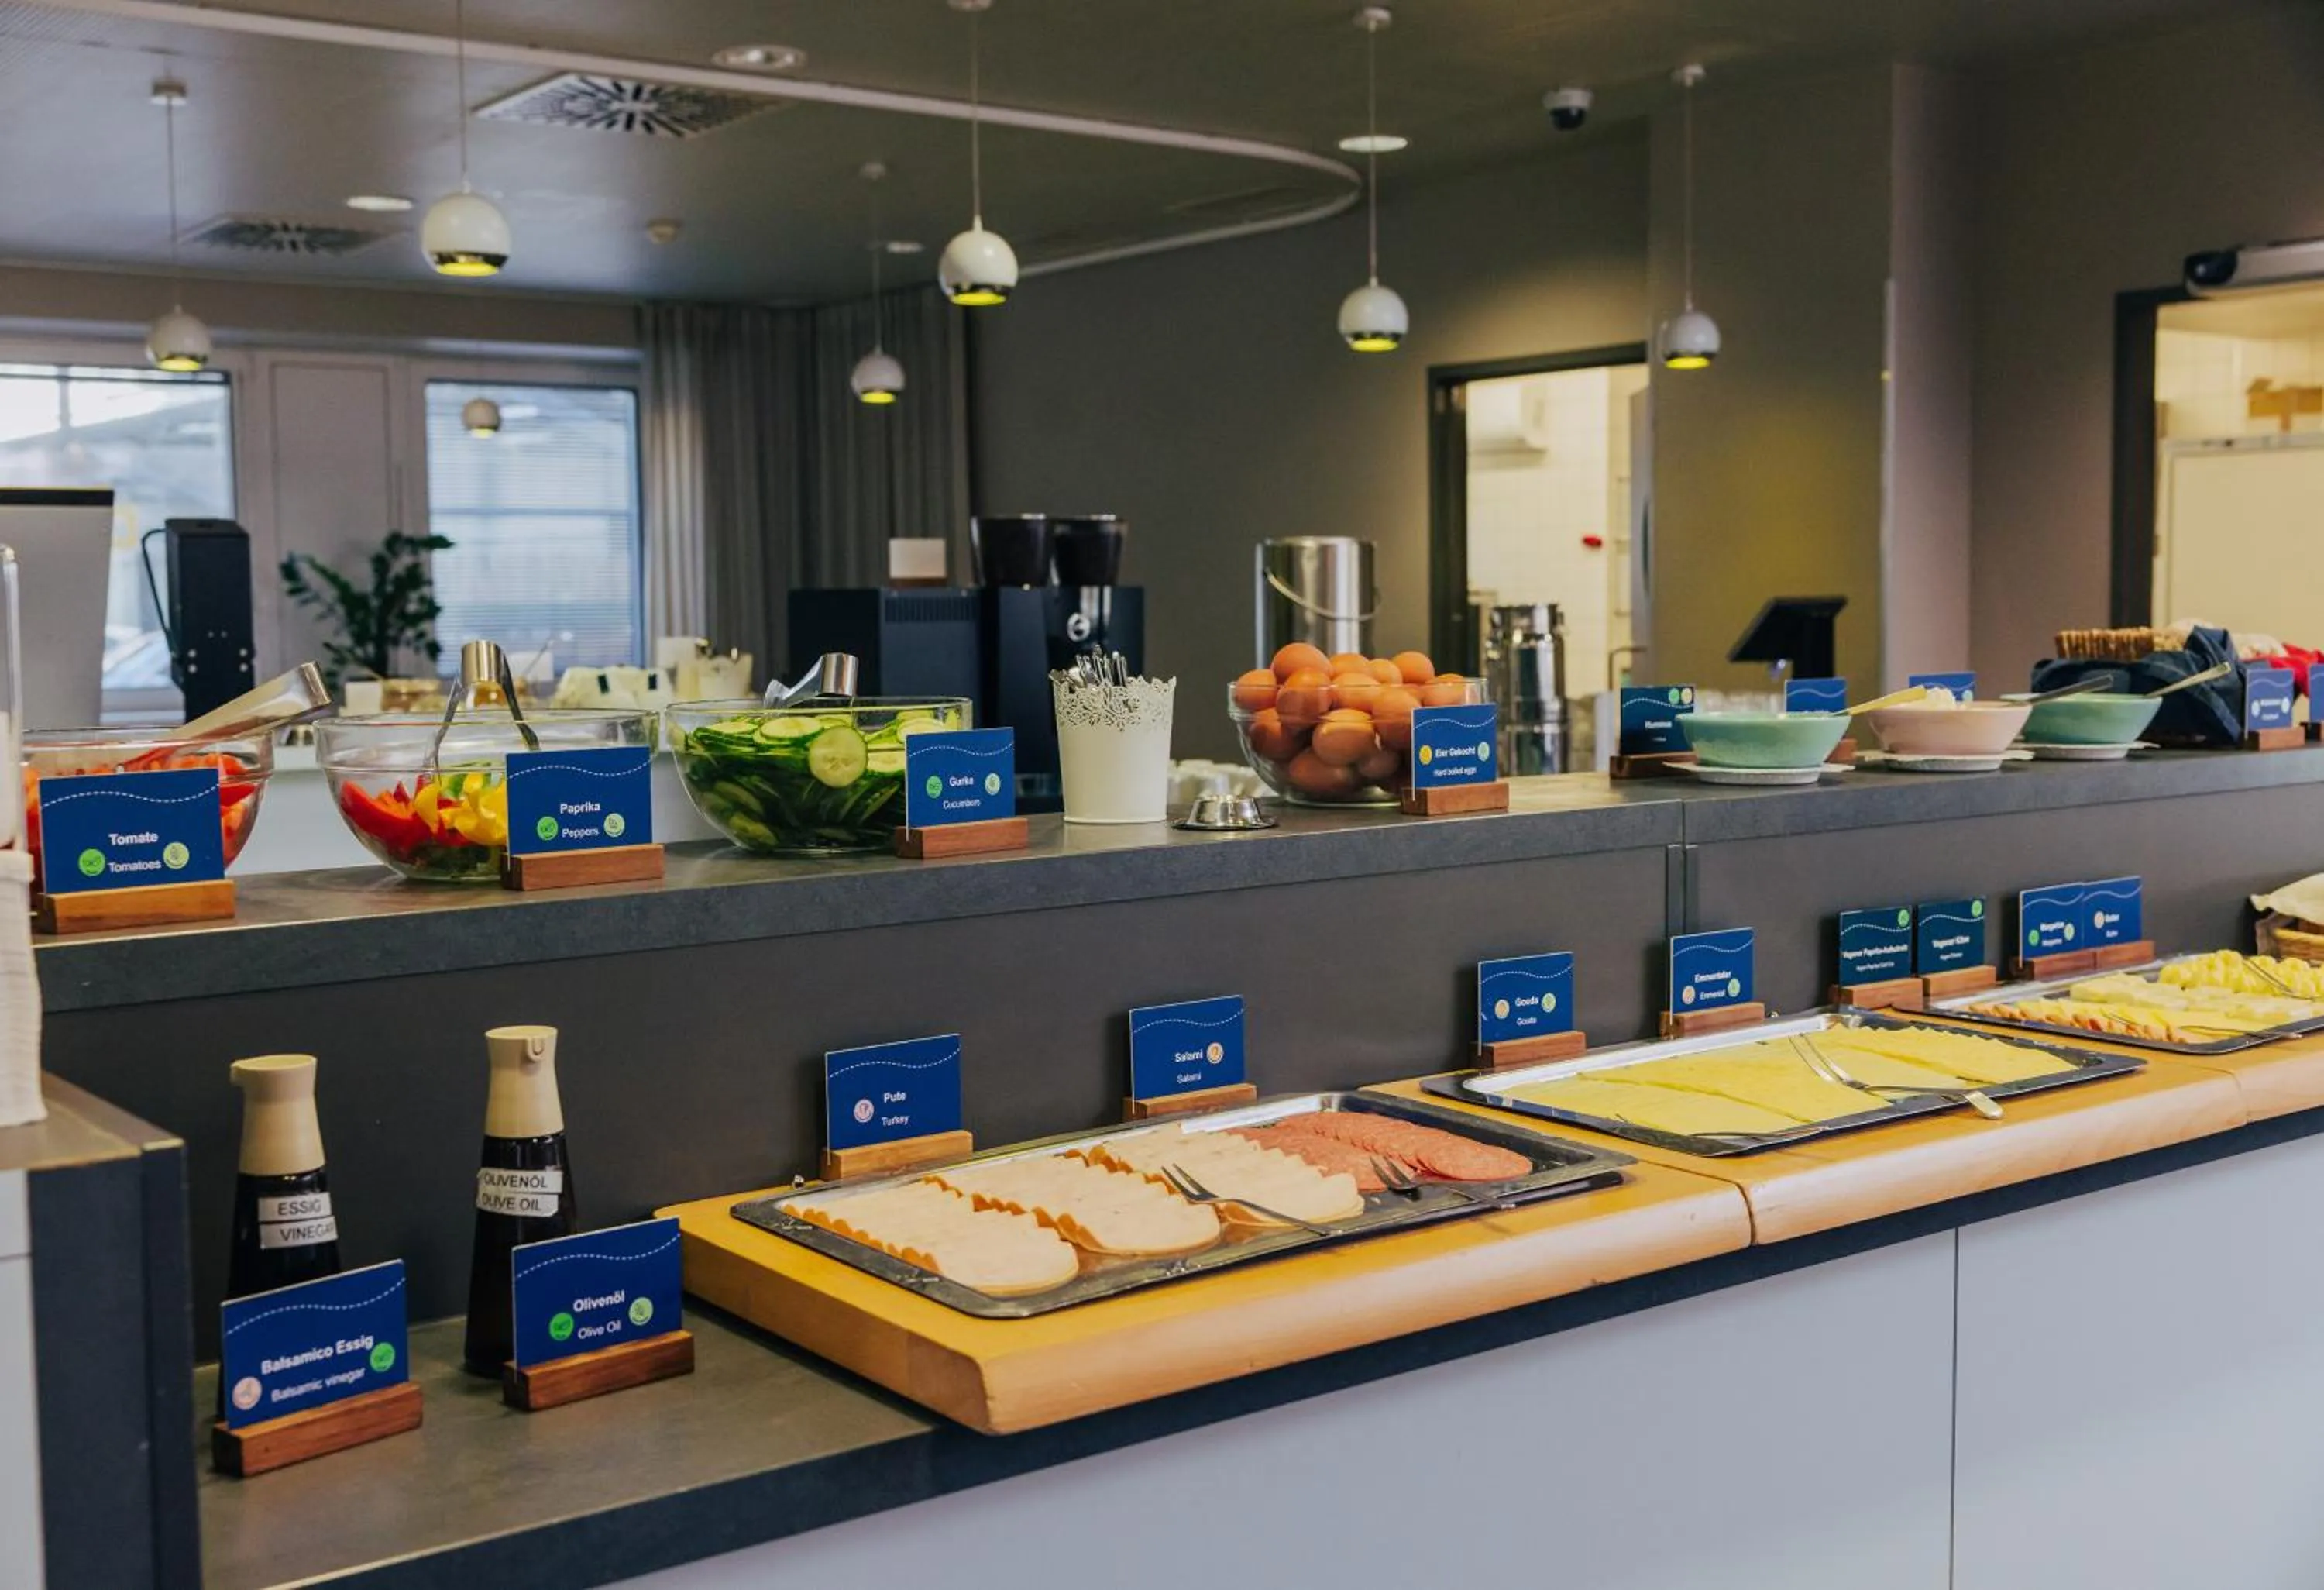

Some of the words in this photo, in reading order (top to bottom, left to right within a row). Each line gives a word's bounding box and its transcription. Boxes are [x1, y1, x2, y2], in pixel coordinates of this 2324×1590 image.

[560, 801, 601, 815] Paprika
[108, 831, 159, 846] Tomate
[562, 827, 599, 839] Peppers
[108, 859, 161, 872] Tomatoes
[1175, 1049, 1203, 1062] Salami
[884, 1091, 906, 1103] Pute
[882, 1115, 909, 1126] Turkey
[277, 1199, 321, 1216] ESSIG
[481, 1192, 514, 1210] OLIVE
[520, 1199, 541, 1211] OIL
[573, 1289, 625, 1312] Olivenöl
[578, 1326, 605, 1340] Olive
[607, 1320, 621, 1332] Oil
[261, 1345, 333, 1375] Balsamico
[335, 1334, 374, 1355] Essig
[271, 1381, 323, 1402] Balsamic
[325, 1367, 366, 1387] vinegar
